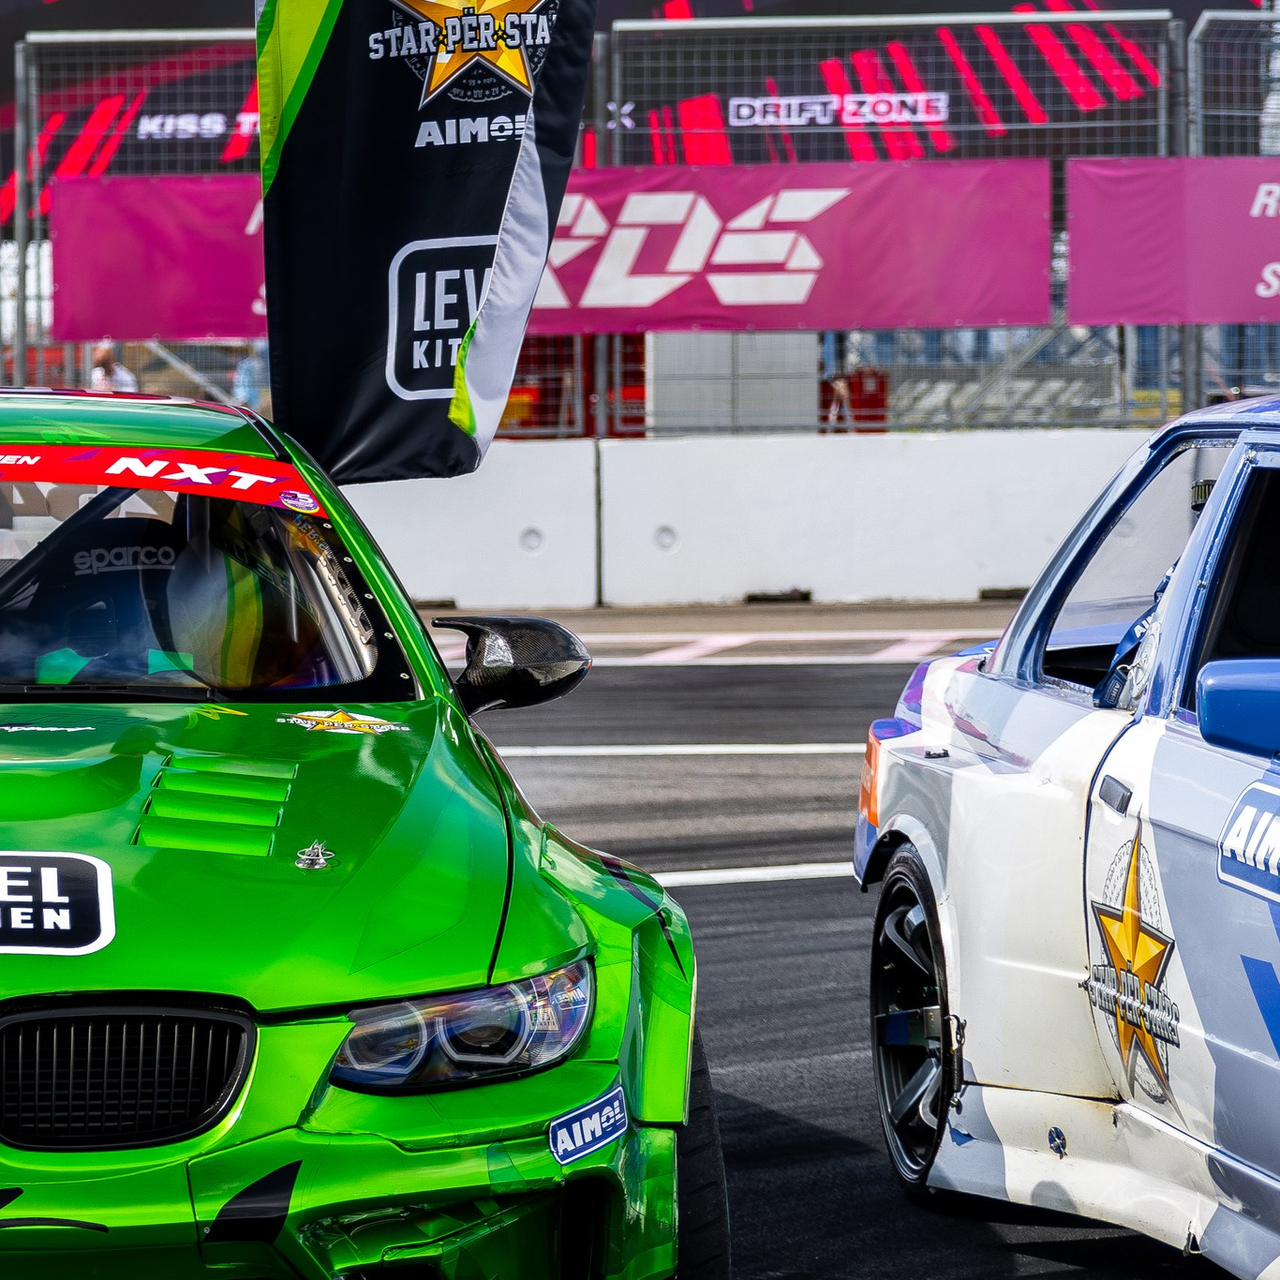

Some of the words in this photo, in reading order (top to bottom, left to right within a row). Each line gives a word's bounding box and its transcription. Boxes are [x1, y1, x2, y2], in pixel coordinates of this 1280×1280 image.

[369, 20, 437, 60] STAR
[505, 13, 552, 47] STA
[137, 112, 227, 139] KISS
[731, 99, 837, 124] DRIFT
[843, 95, 948, 121] ZONE
[413, 267, 493, 331] LEV
[104, 456, 277, 490] NXT
[73, 545, 176, 576] sparco
[1223, 805, 1280, 876] AIM
[556, 1099, 625, 1155] AIMOL
